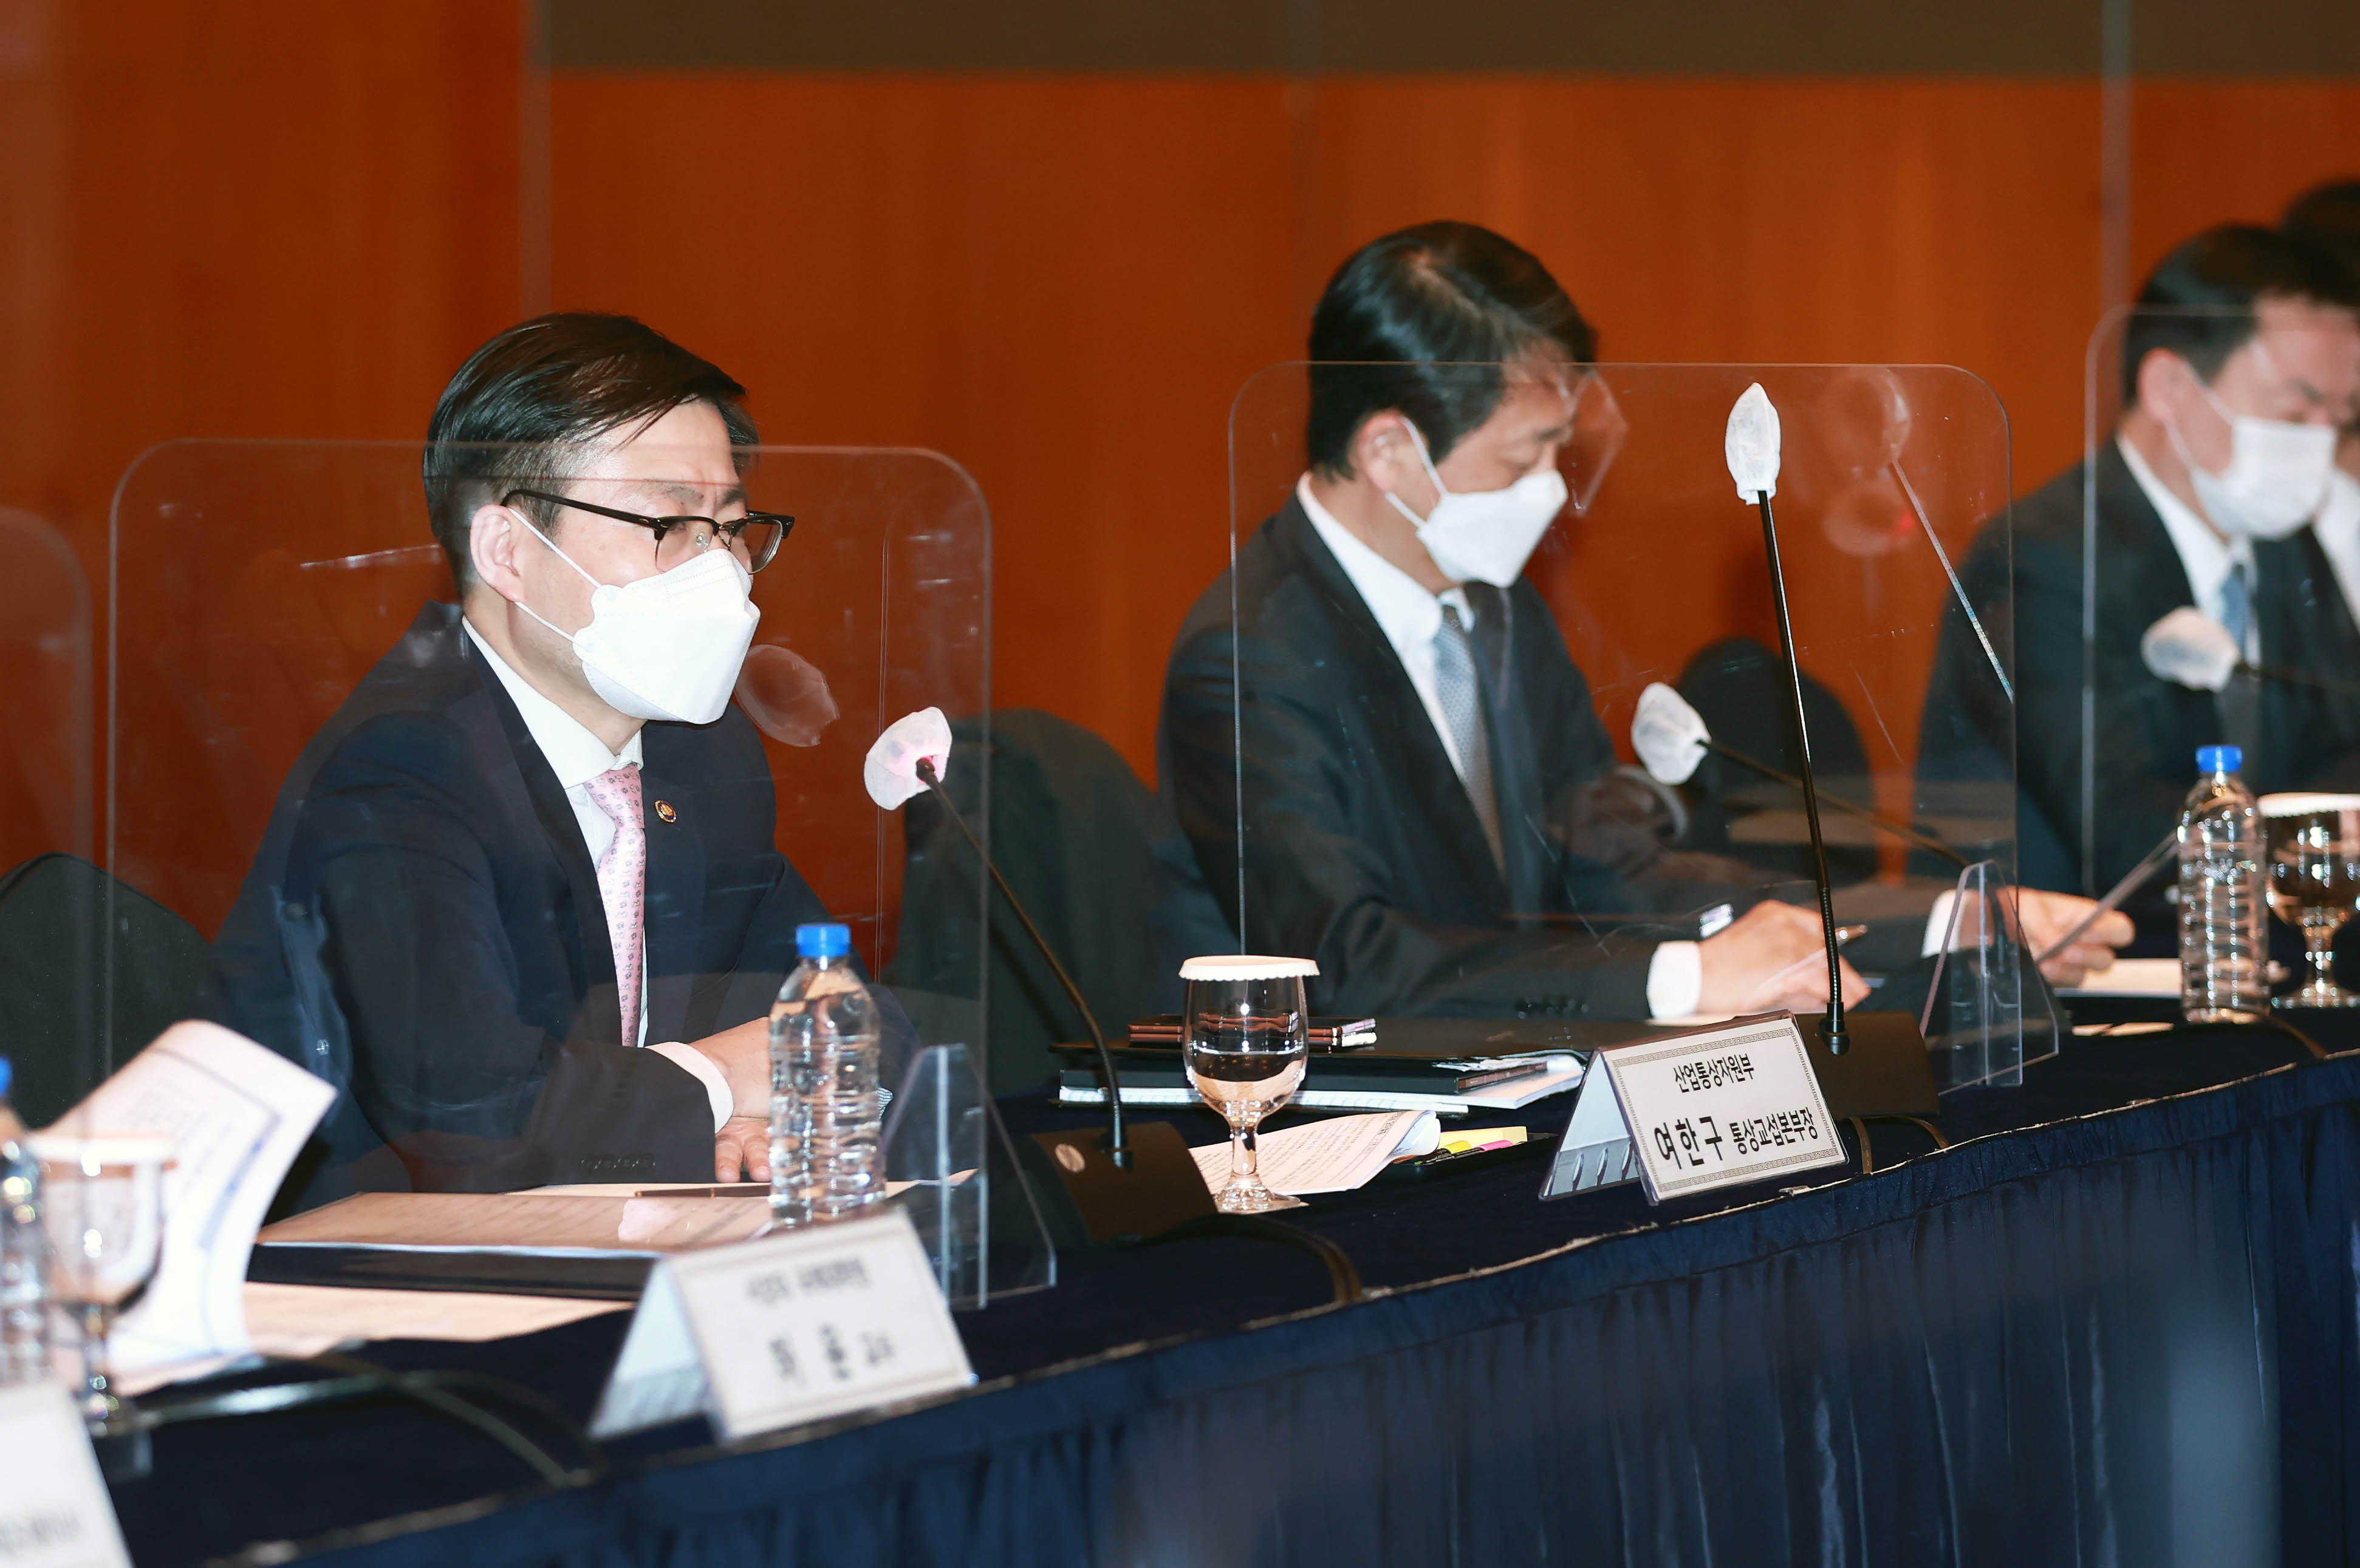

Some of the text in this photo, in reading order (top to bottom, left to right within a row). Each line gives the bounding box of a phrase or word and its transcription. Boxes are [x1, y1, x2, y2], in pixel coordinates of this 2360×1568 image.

[1672, 1053, 1755, 1094] 산업통상자원부
[1654, 1106, 1819, 1170] 여한구 통상교섭본부장
